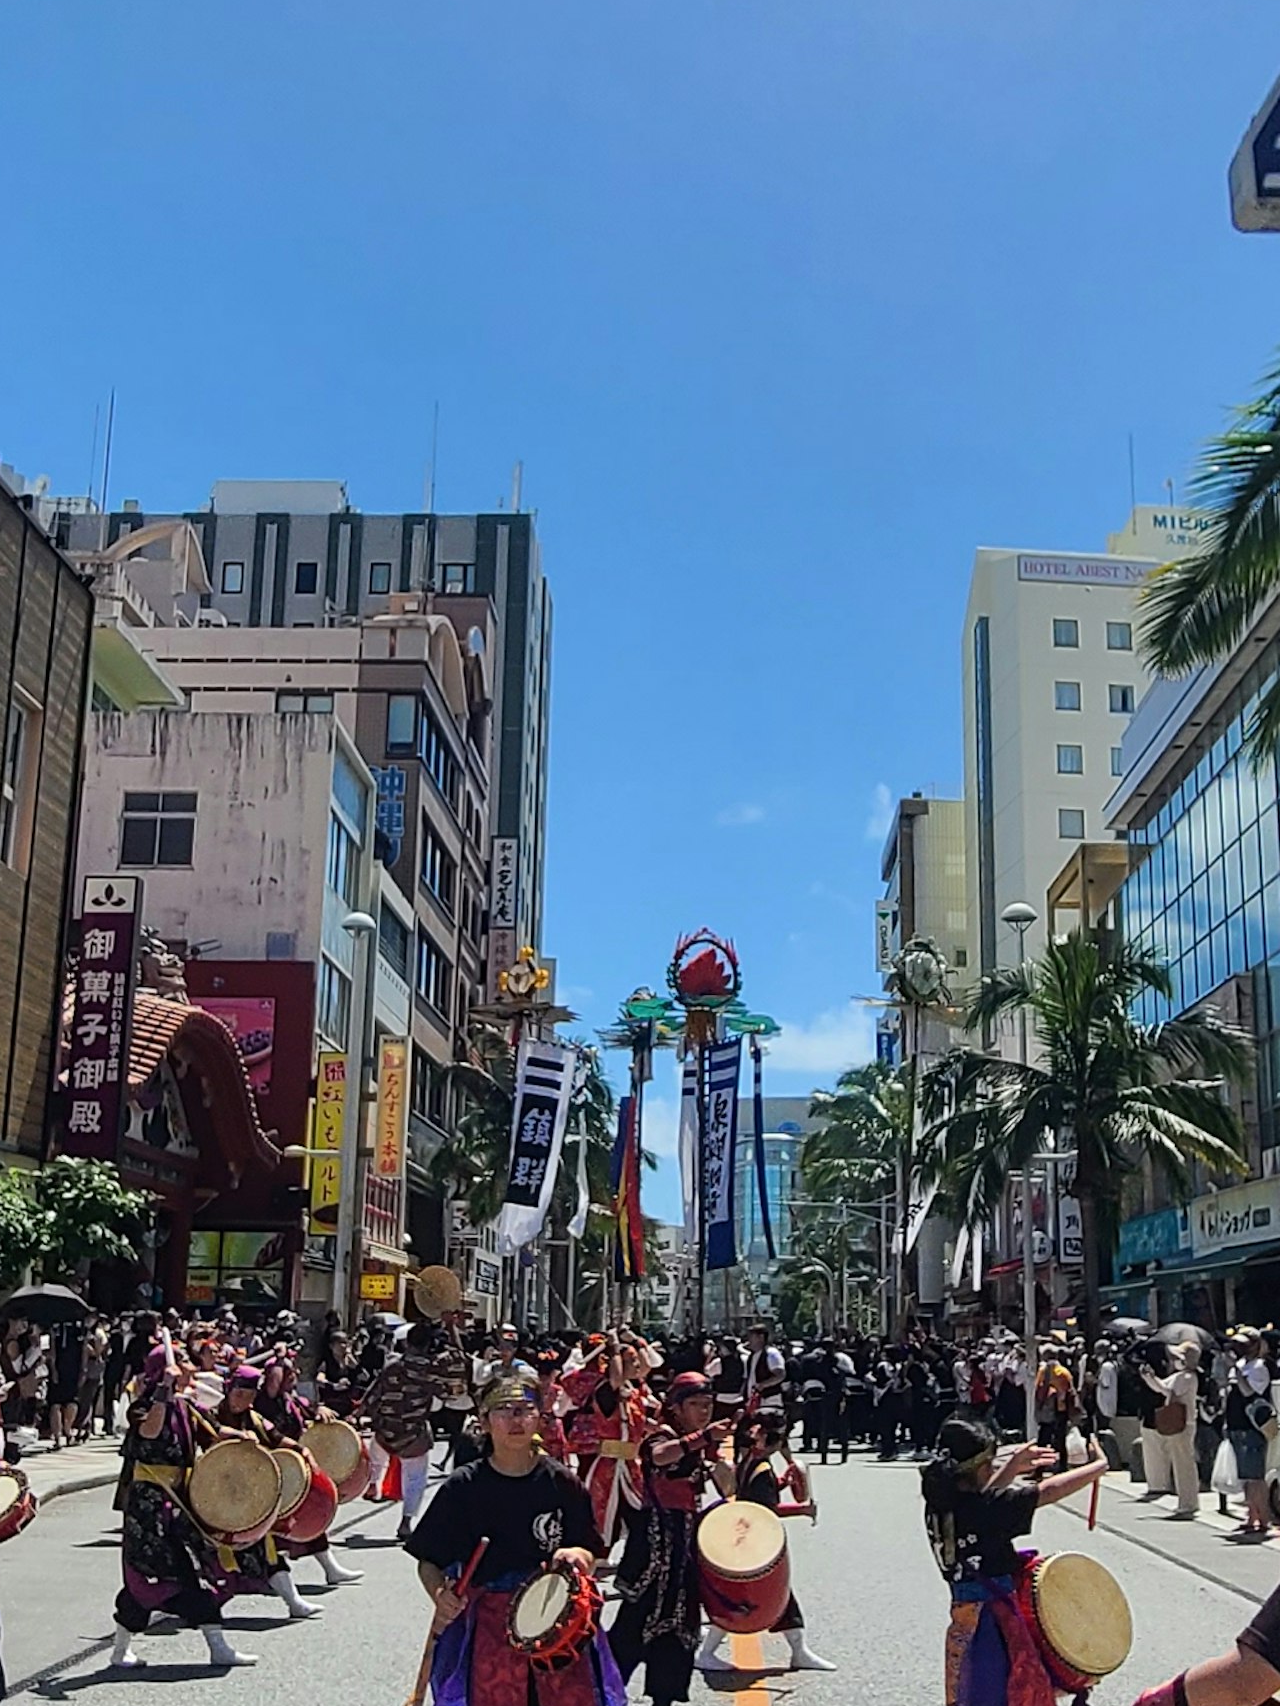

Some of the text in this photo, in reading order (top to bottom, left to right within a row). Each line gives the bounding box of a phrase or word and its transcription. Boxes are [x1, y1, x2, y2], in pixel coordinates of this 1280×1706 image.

[1023, 560, 1071, 576] HOTEL
[1075, 564, 1121, 579] ABEST
[68, 928, 116, 1134] 御菓子御殿
